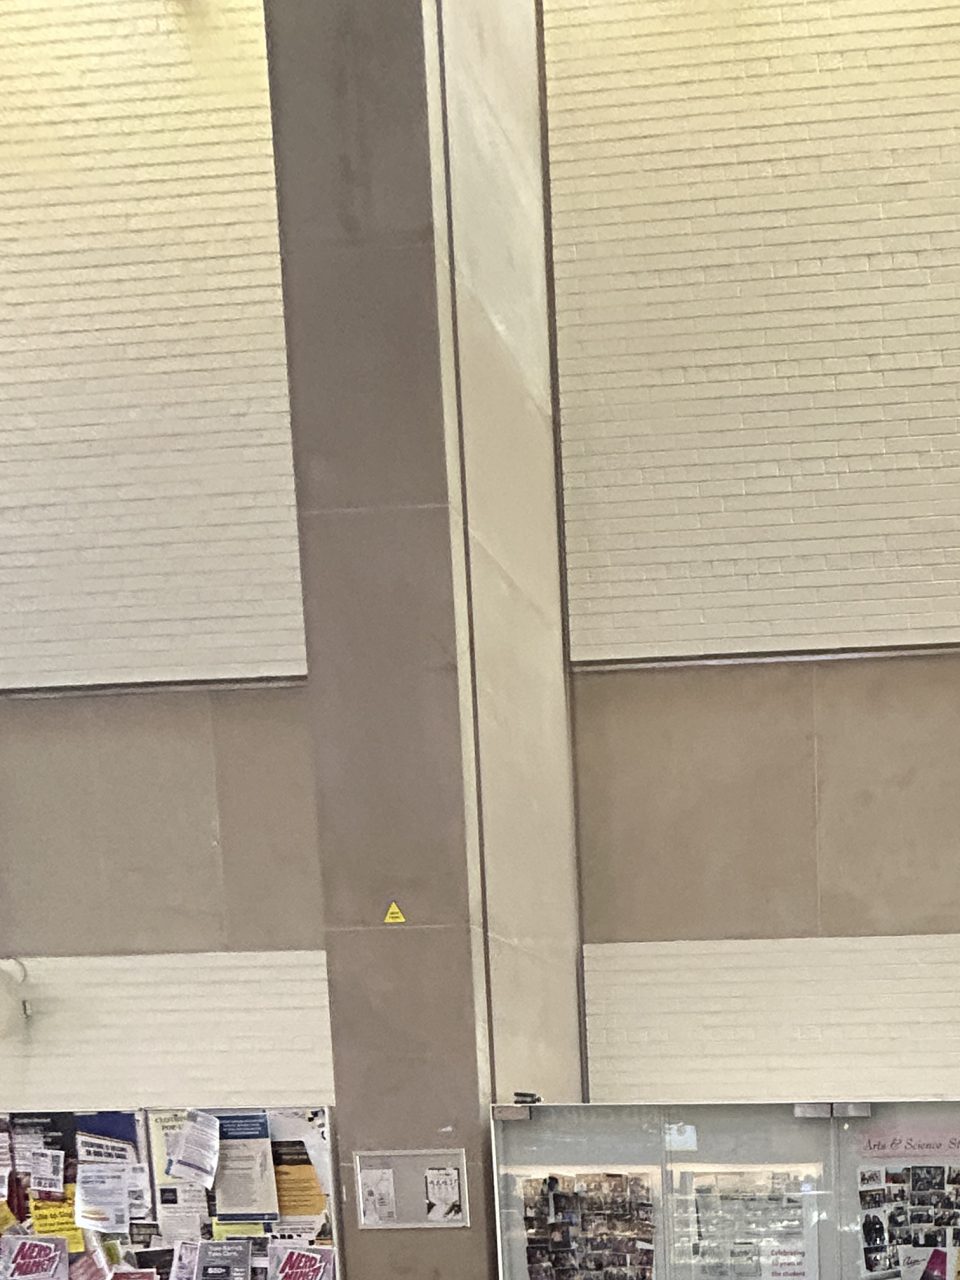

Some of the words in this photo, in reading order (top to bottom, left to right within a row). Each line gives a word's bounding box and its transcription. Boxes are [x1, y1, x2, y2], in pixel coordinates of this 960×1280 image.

[864, 1138, 887, 1150] Arts
[890, 1138, 903, 1149] &
[904, 1137, 943, 1150] Science
[279, 1251, 318, 1274] NERD
